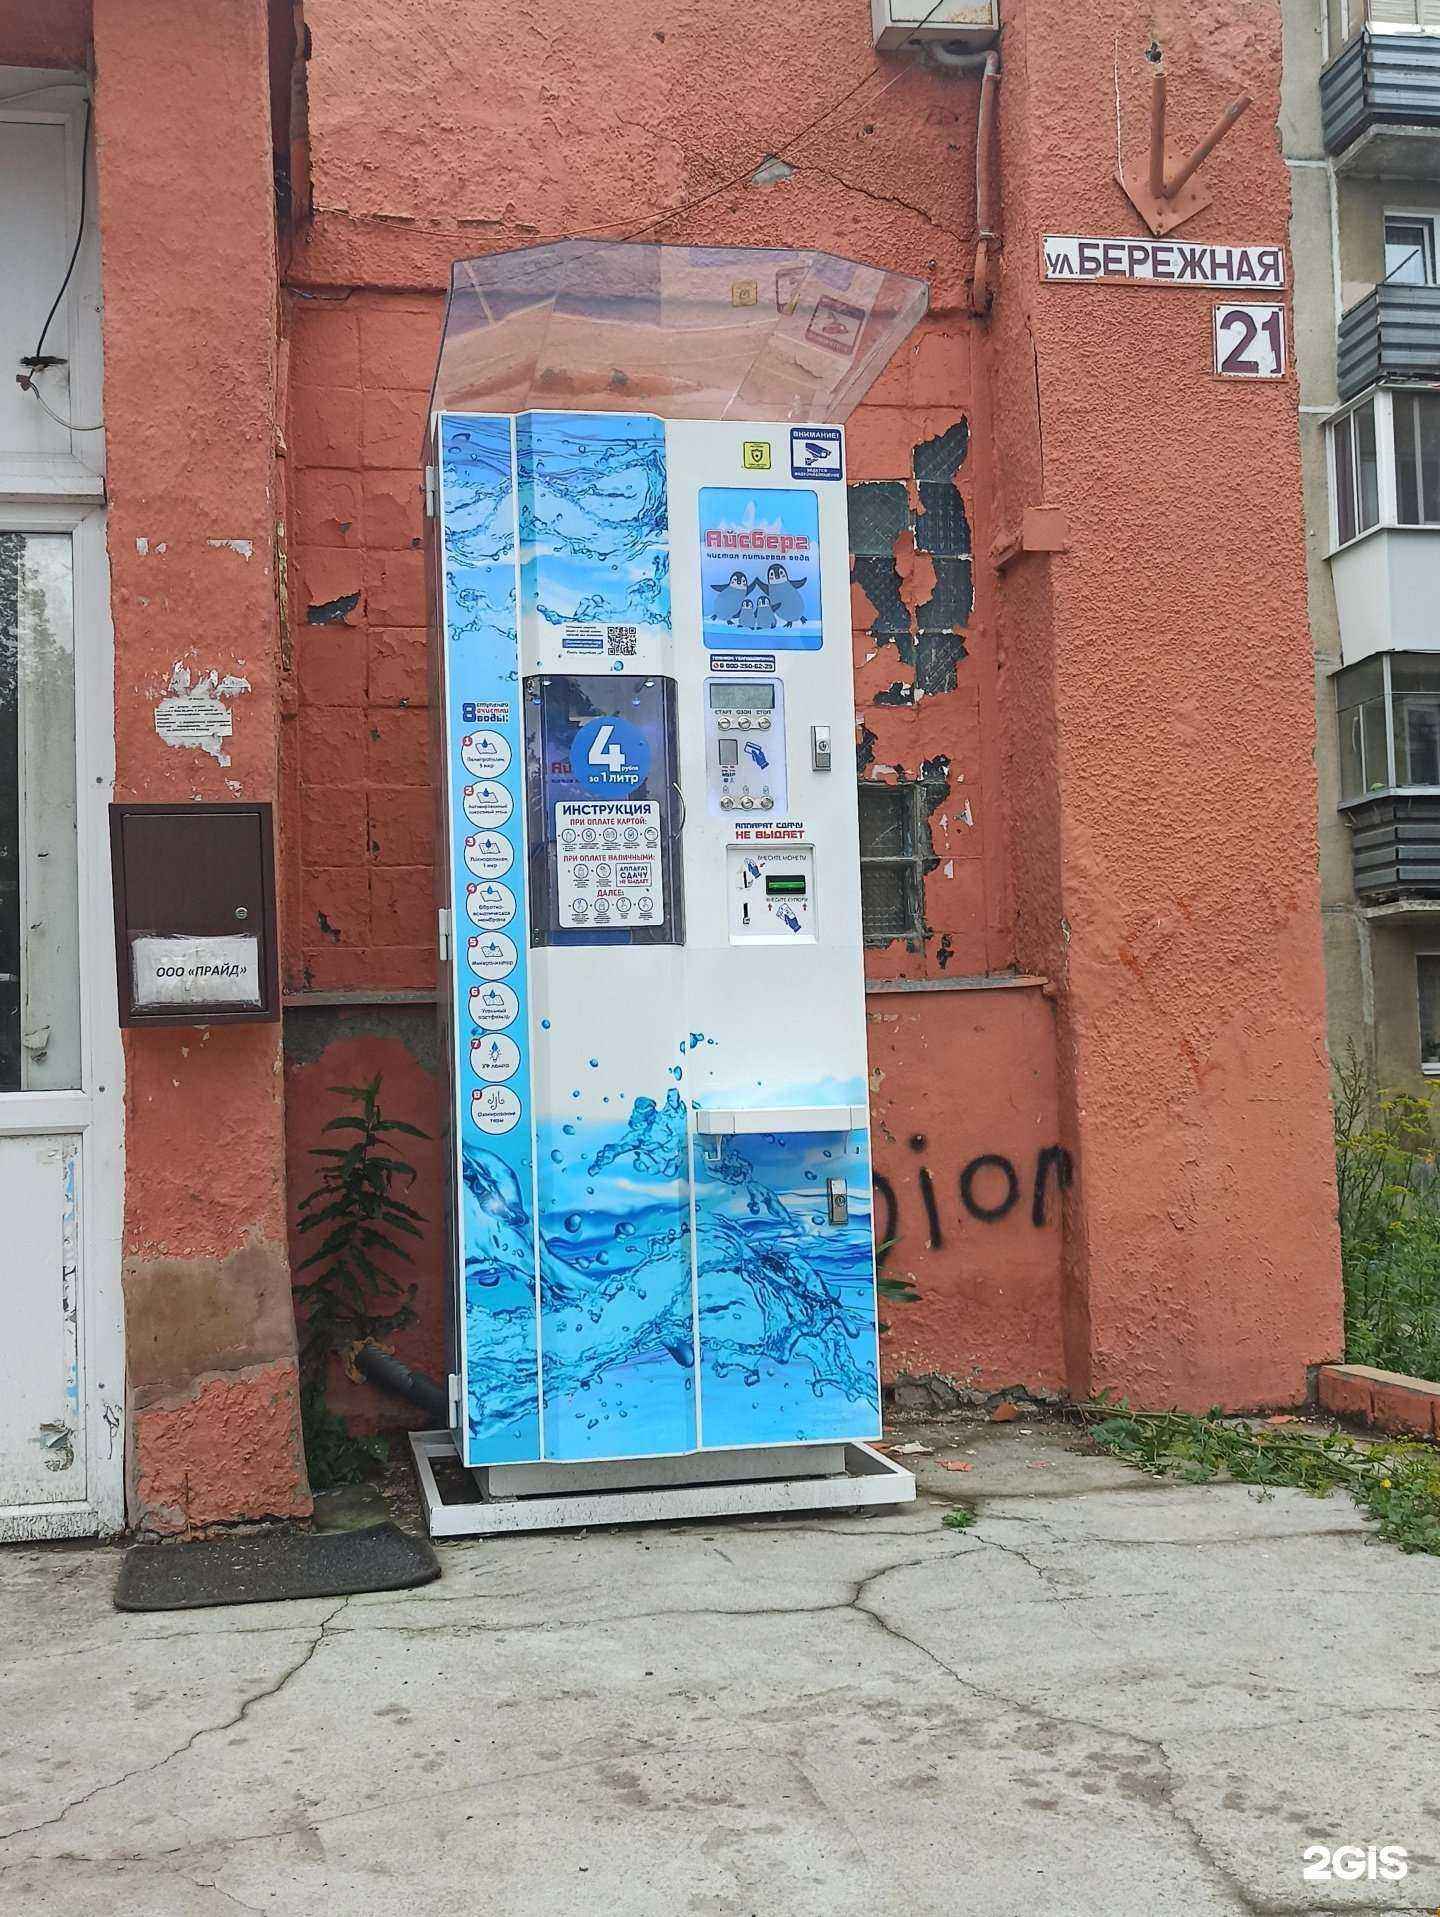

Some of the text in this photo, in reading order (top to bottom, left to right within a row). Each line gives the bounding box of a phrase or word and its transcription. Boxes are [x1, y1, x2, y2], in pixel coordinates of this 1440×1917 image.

[1219, 309, 1282, 374] 21
[792, 430, 840, 439] ВНИМАНИЕ!
[706, 530, 810, 554] Айсберг
[742, 553, 786, 561] питьевая
[788, 554, 810, 562] вода
[462, 702, 477, 723] 8
[476, 713, 509, 723] воды:
[588, 724, 626, 772] 4
[601, 771, 608, 783] 1
[608, 774, 639, 784] литр
[562, 803, 652, 816] ИНСТРУКЦИЯ
[570, 816, 647, 826] ПРИ ОПЛАТЕ КАРТОЙ:
[735, 830, 805, 840] НЕ ВЫДАЕТ
[580, 854, 607, 862] ОПЛАТЕ
[608, 853, 656, 862] НАЛИЧНЫМИ:
[619, 871, 648, 879] СДАЧУ
[596, 888, 625, 897] ДАЛЕЕ:
[156, 962, 247, 978] ООО «ПРАЙД»
